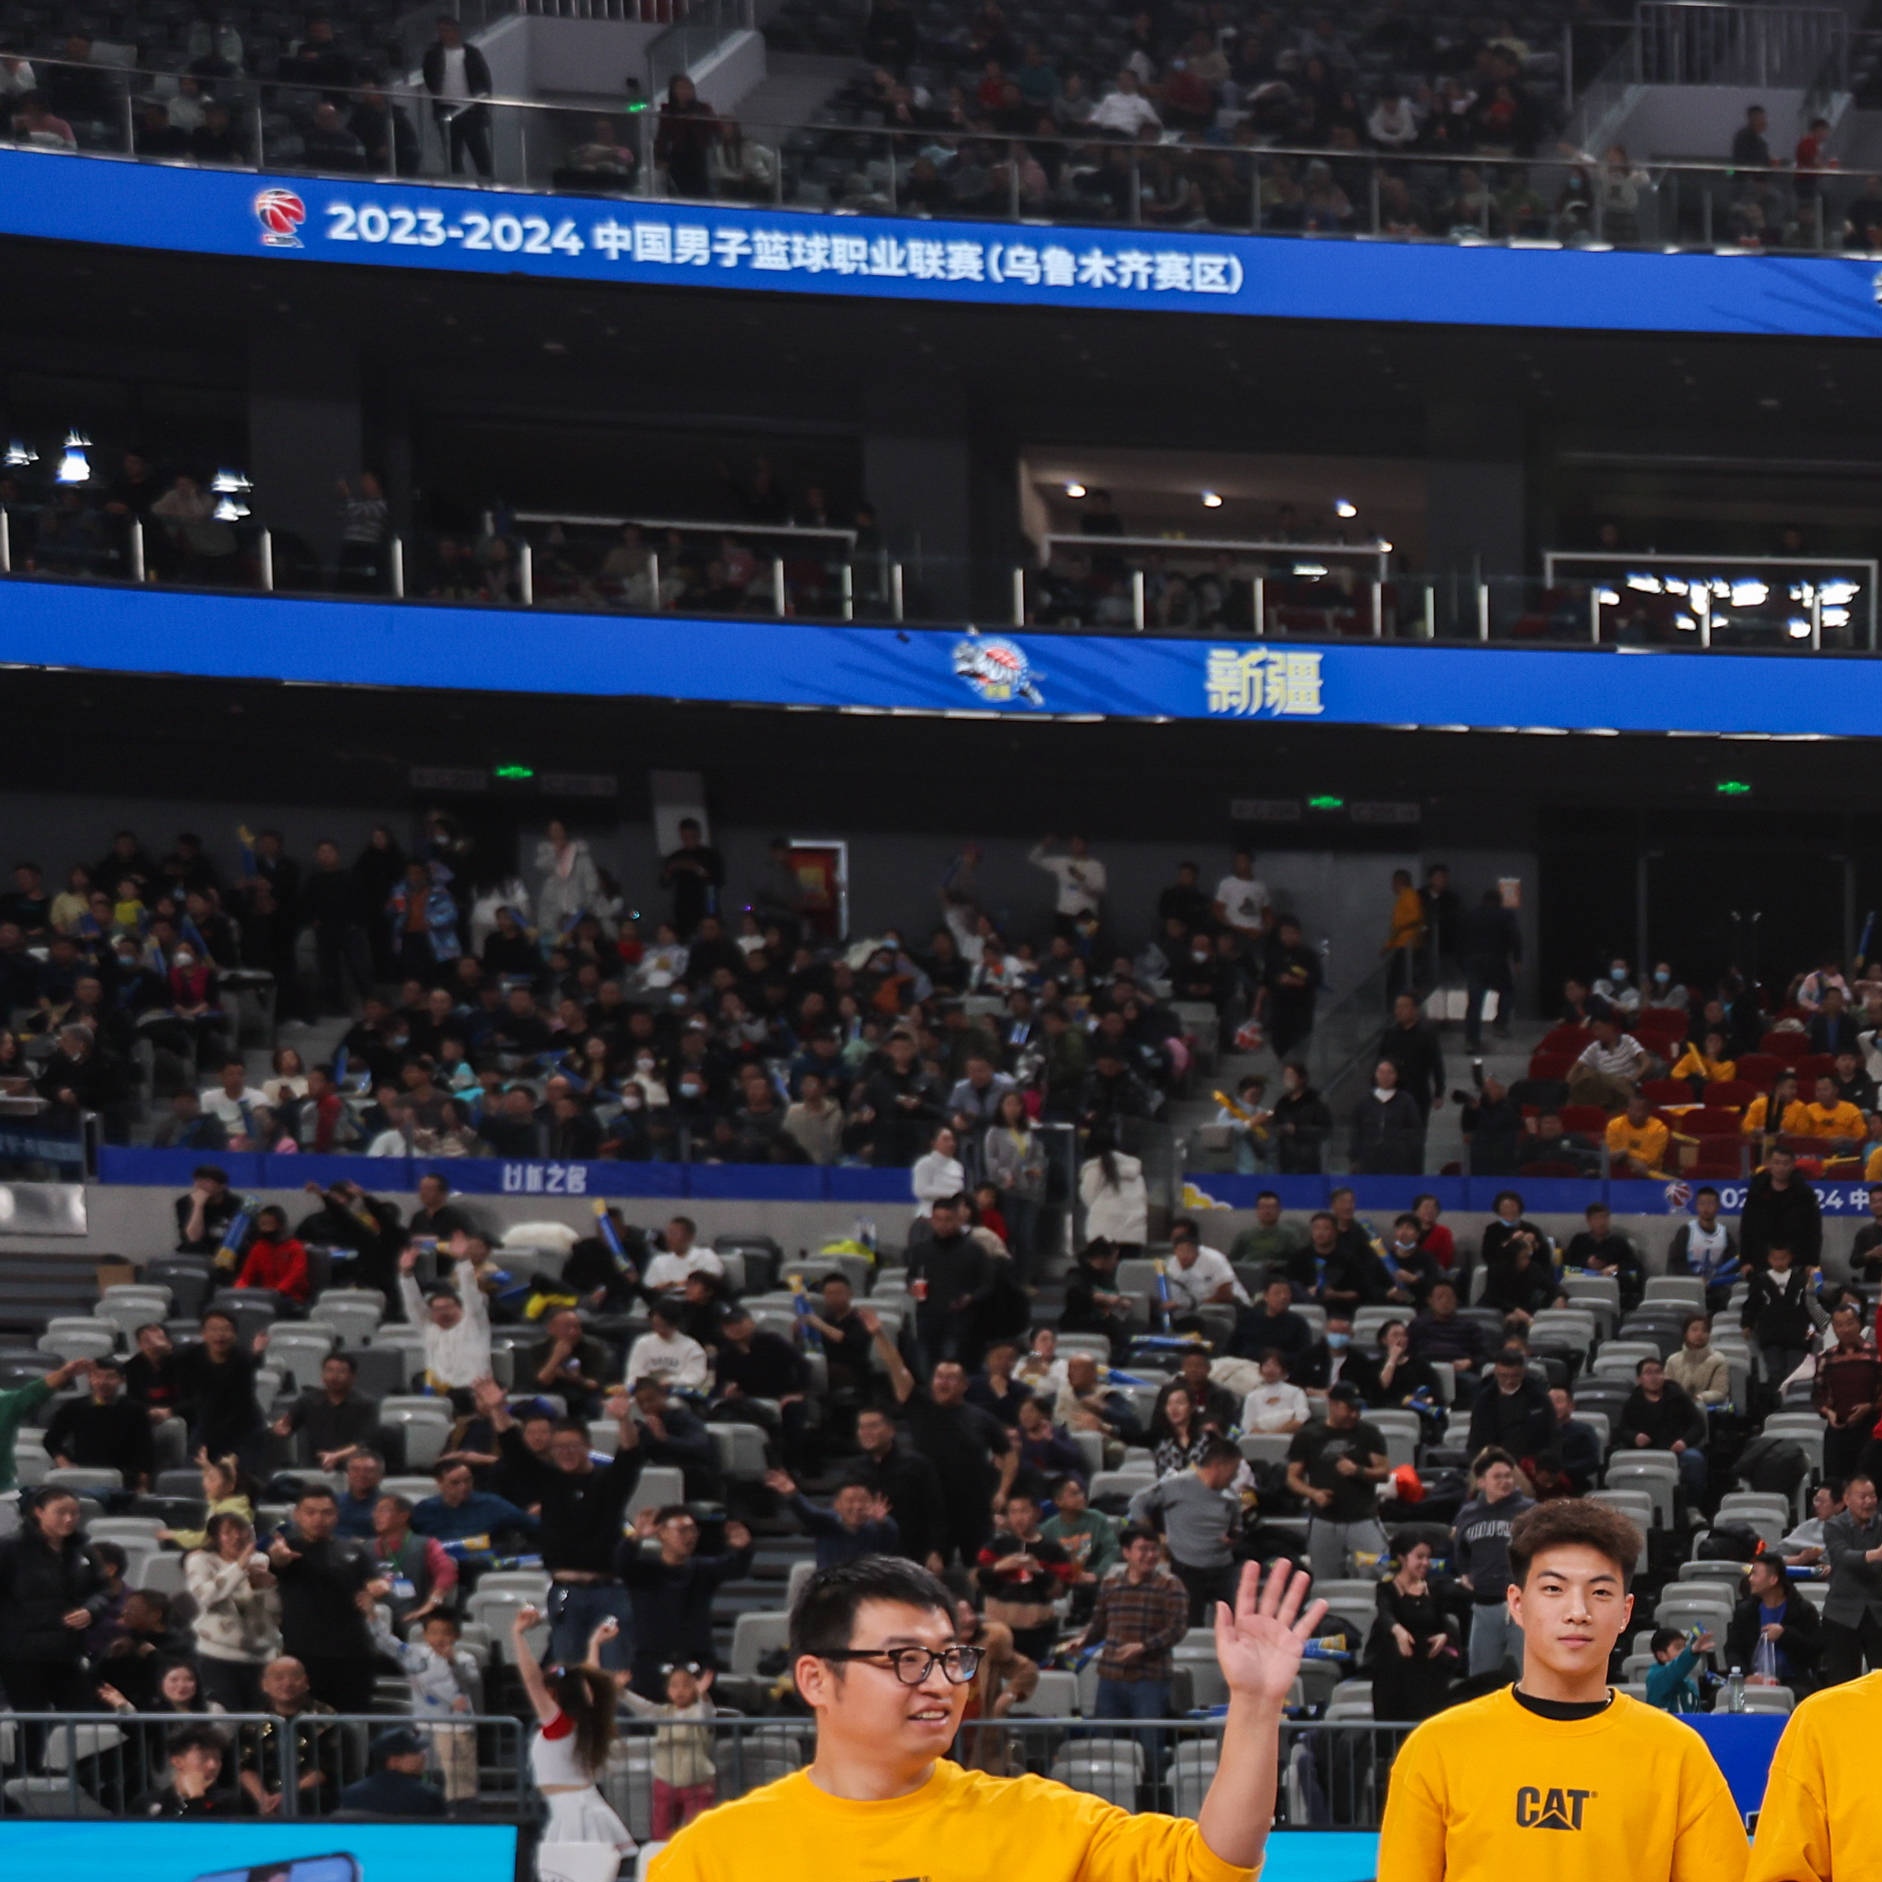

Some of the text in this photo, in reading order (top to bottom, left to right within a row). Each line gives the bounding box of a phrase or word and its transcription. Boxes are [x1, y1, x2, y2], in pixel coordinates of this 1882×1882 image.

[325, 204, 1245, 296] 2023-2024 中国男子篮球职业联赛(乌鲁木齐赛区)
[1205, 646, 1325, 717] 新疆
[1516, 1786, 1589, 1831] CAT
